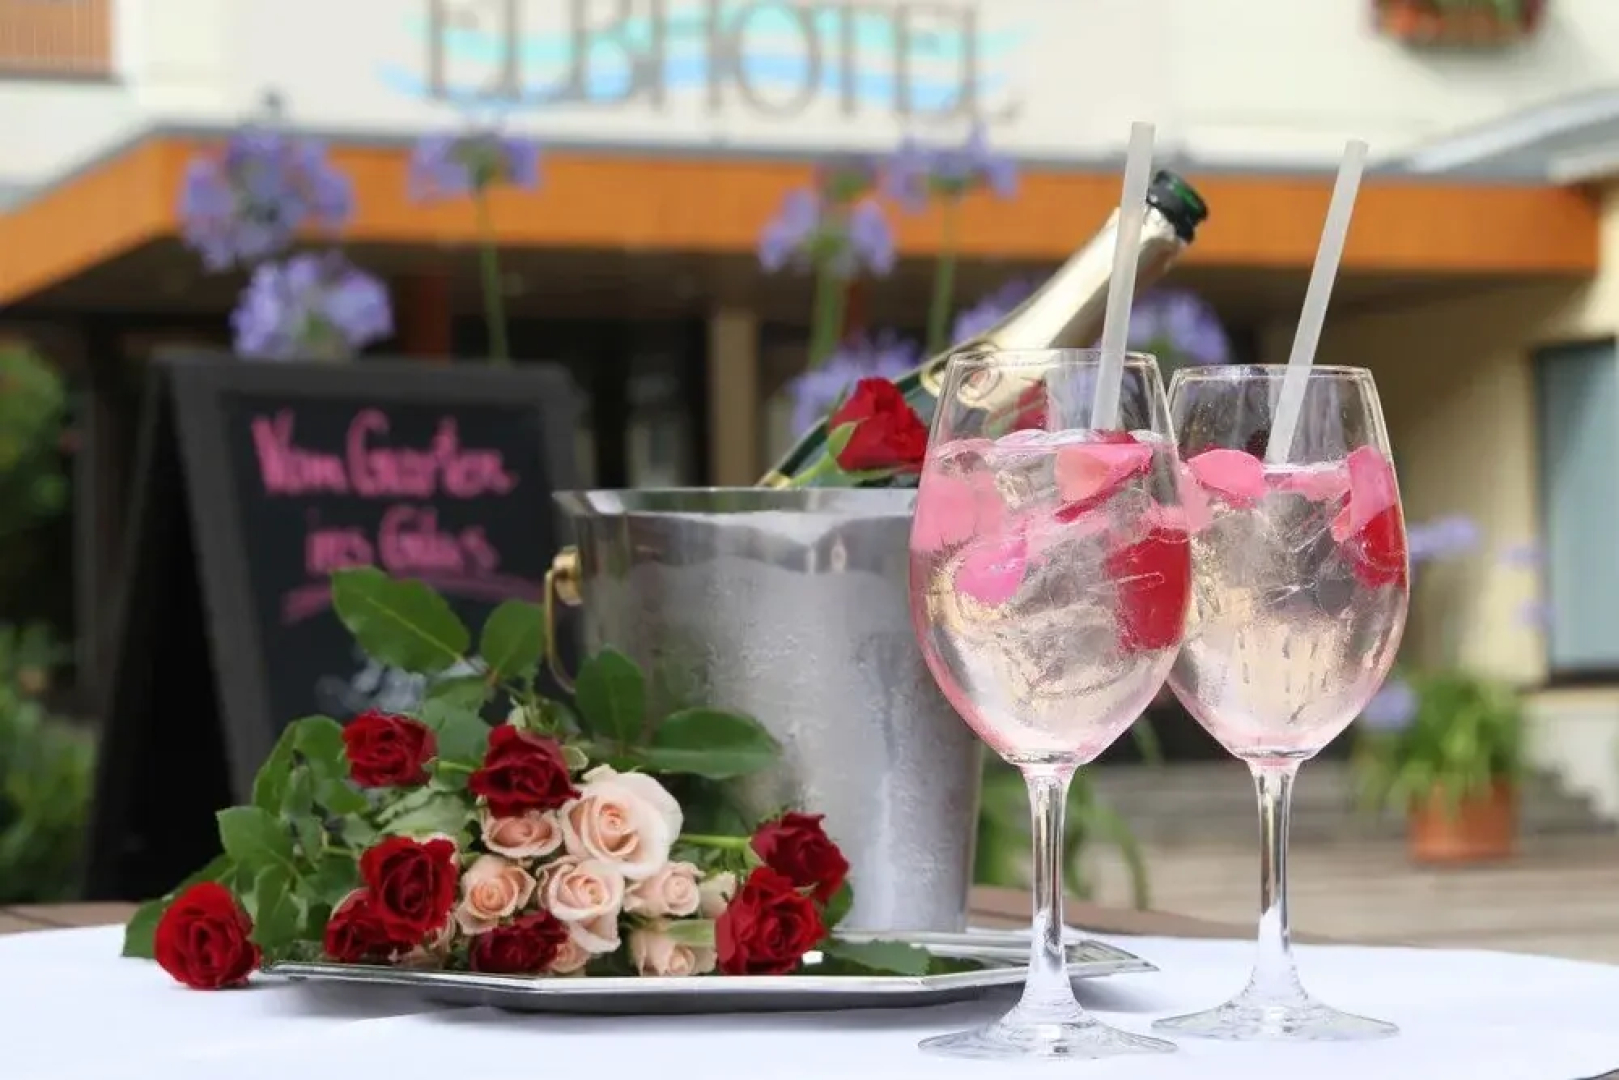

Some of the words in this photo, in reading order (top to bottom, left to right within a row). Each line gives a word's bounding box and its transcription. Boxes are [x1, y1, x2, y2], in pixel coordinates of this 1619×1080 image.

[427, 0, 1022, 121] ELBHOTEL
[250, 407, 347, 494] Vom
[347, 407, 519, 496] Garten
